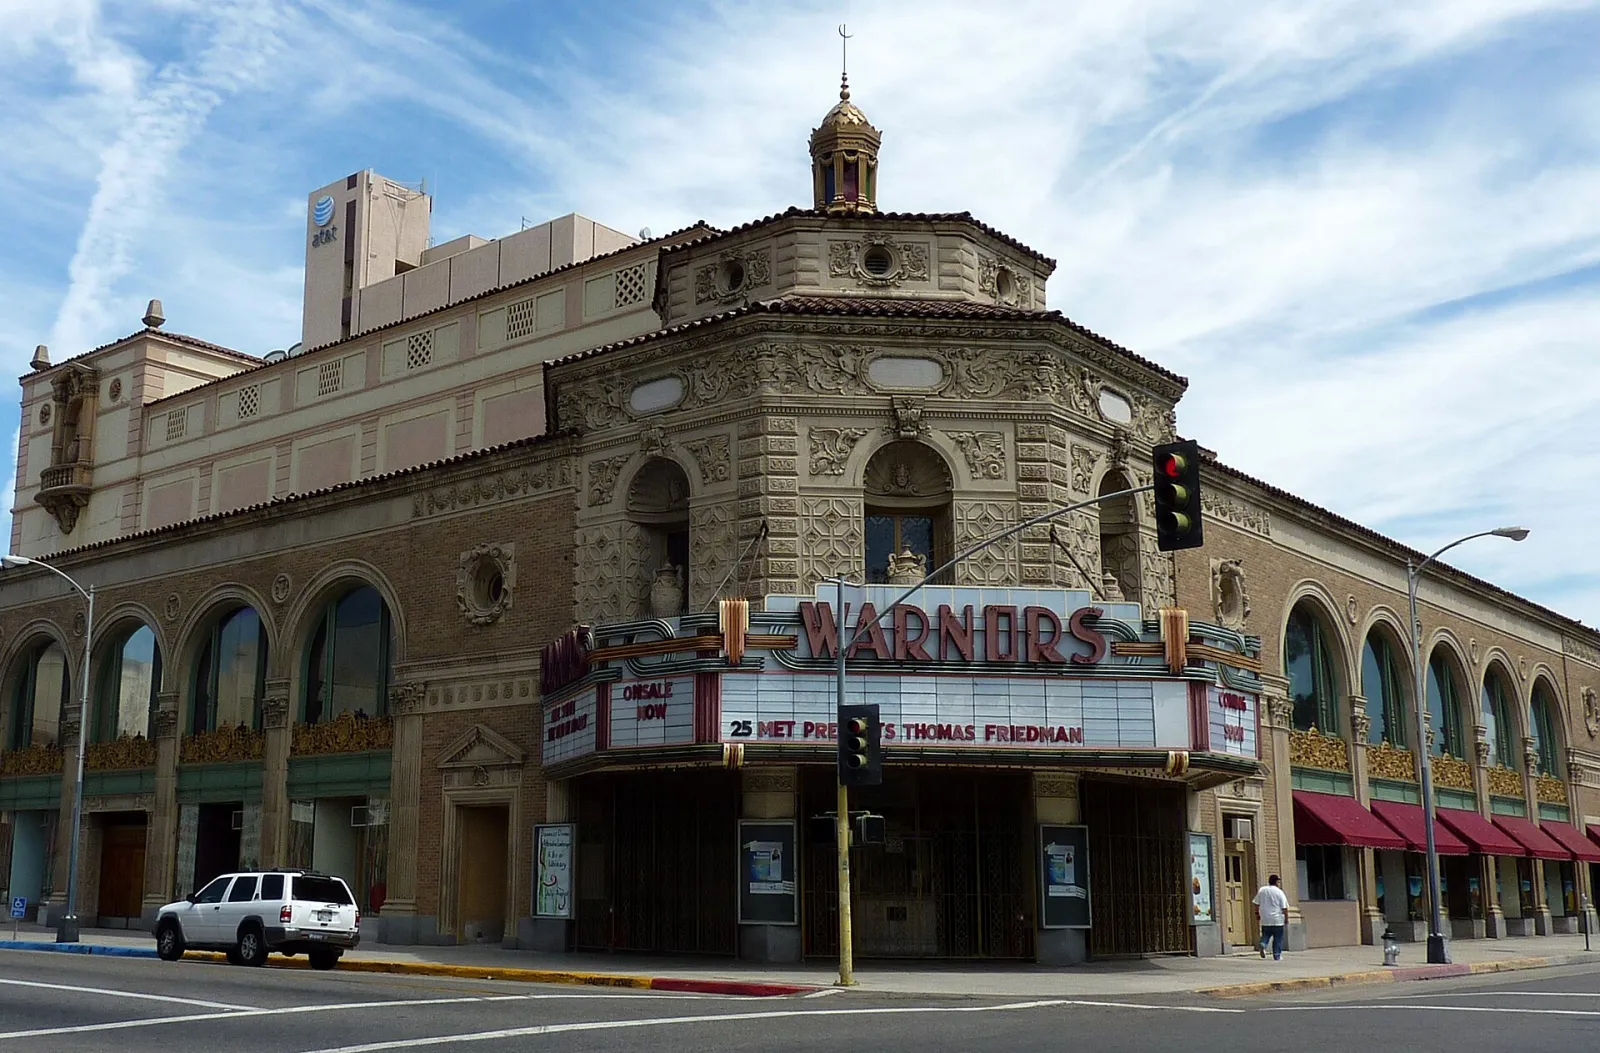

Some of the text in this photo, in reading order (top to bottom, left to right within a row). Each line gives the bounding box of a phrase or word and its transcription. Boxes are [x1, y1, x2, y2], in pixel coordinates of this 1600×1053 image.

[799, 601, 1106, 664] WARNORS
[637, 703, 667, 721] NOW
[730, 720, 1082, 743] 25 MET PRETS THOMAS FRIEDMAN
